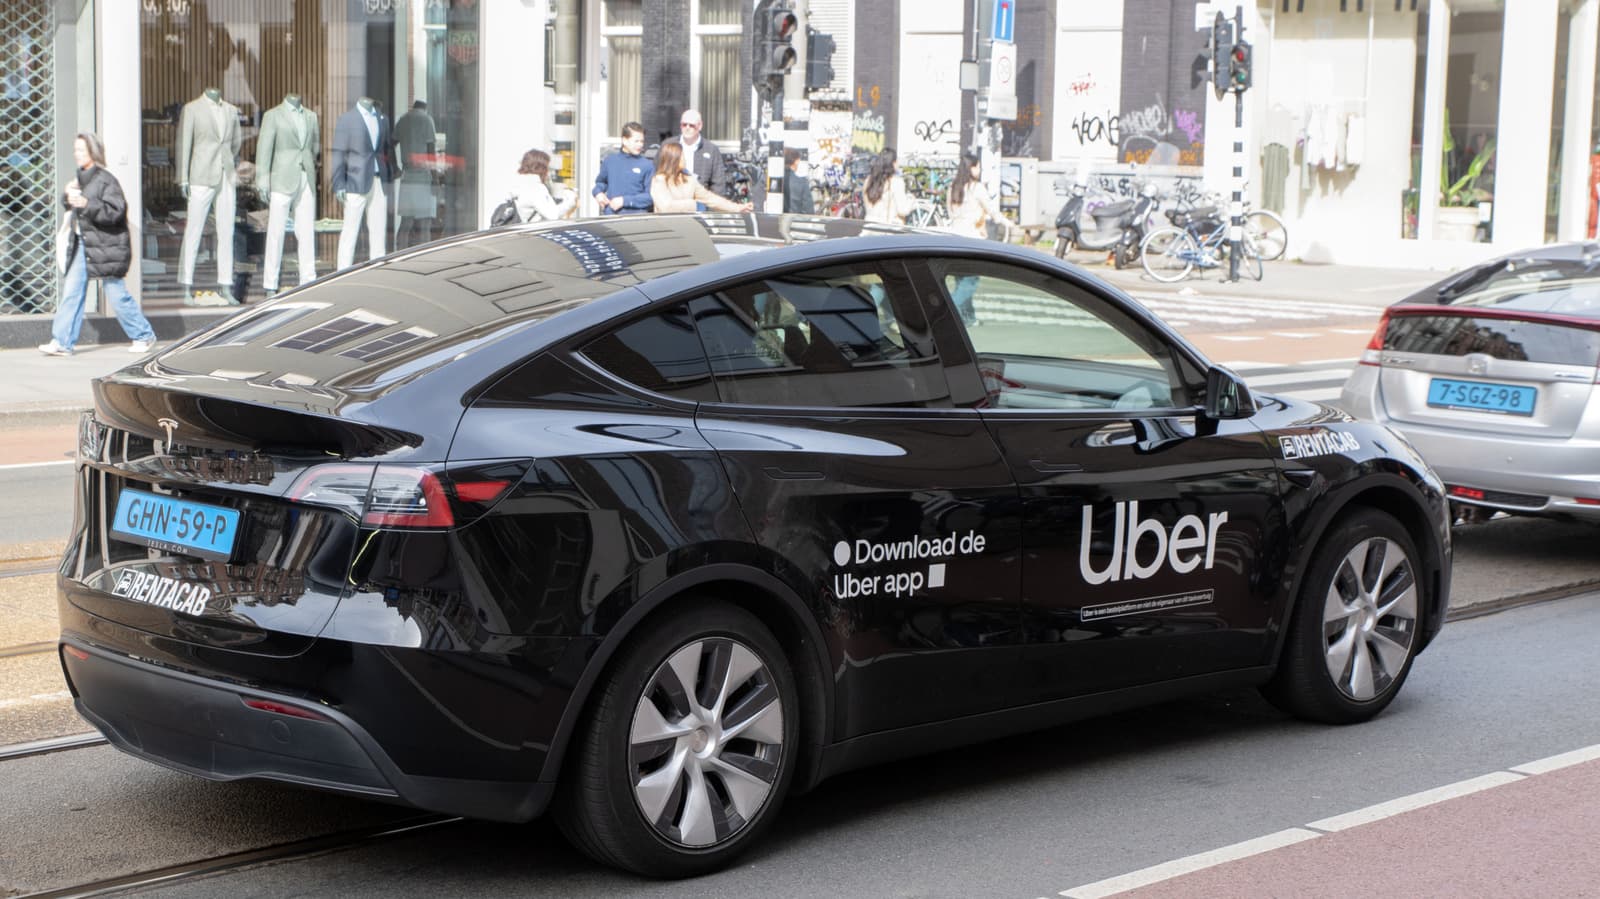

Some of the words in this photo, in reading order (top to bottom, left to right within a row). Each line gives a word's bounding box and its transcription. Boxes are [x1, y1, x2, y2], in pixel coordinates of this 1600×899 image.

[1439, 383, 1521, 408] 7-SGZ-98
[1294, 431, 1361, 458] RENTACAB
[127, 498, 227, 545] GHN-59-P
[146, 540, 188, 554] TESLA.COM
[855, 531, 956, 564] Download
[959, 529, 986, 554] de
[1079, 500, 1229, 585] Uber
[128, 571, 211, 617] RENTACAB
[834, 573, 881, 599] Uber
[884, 571, 924, 598] app
